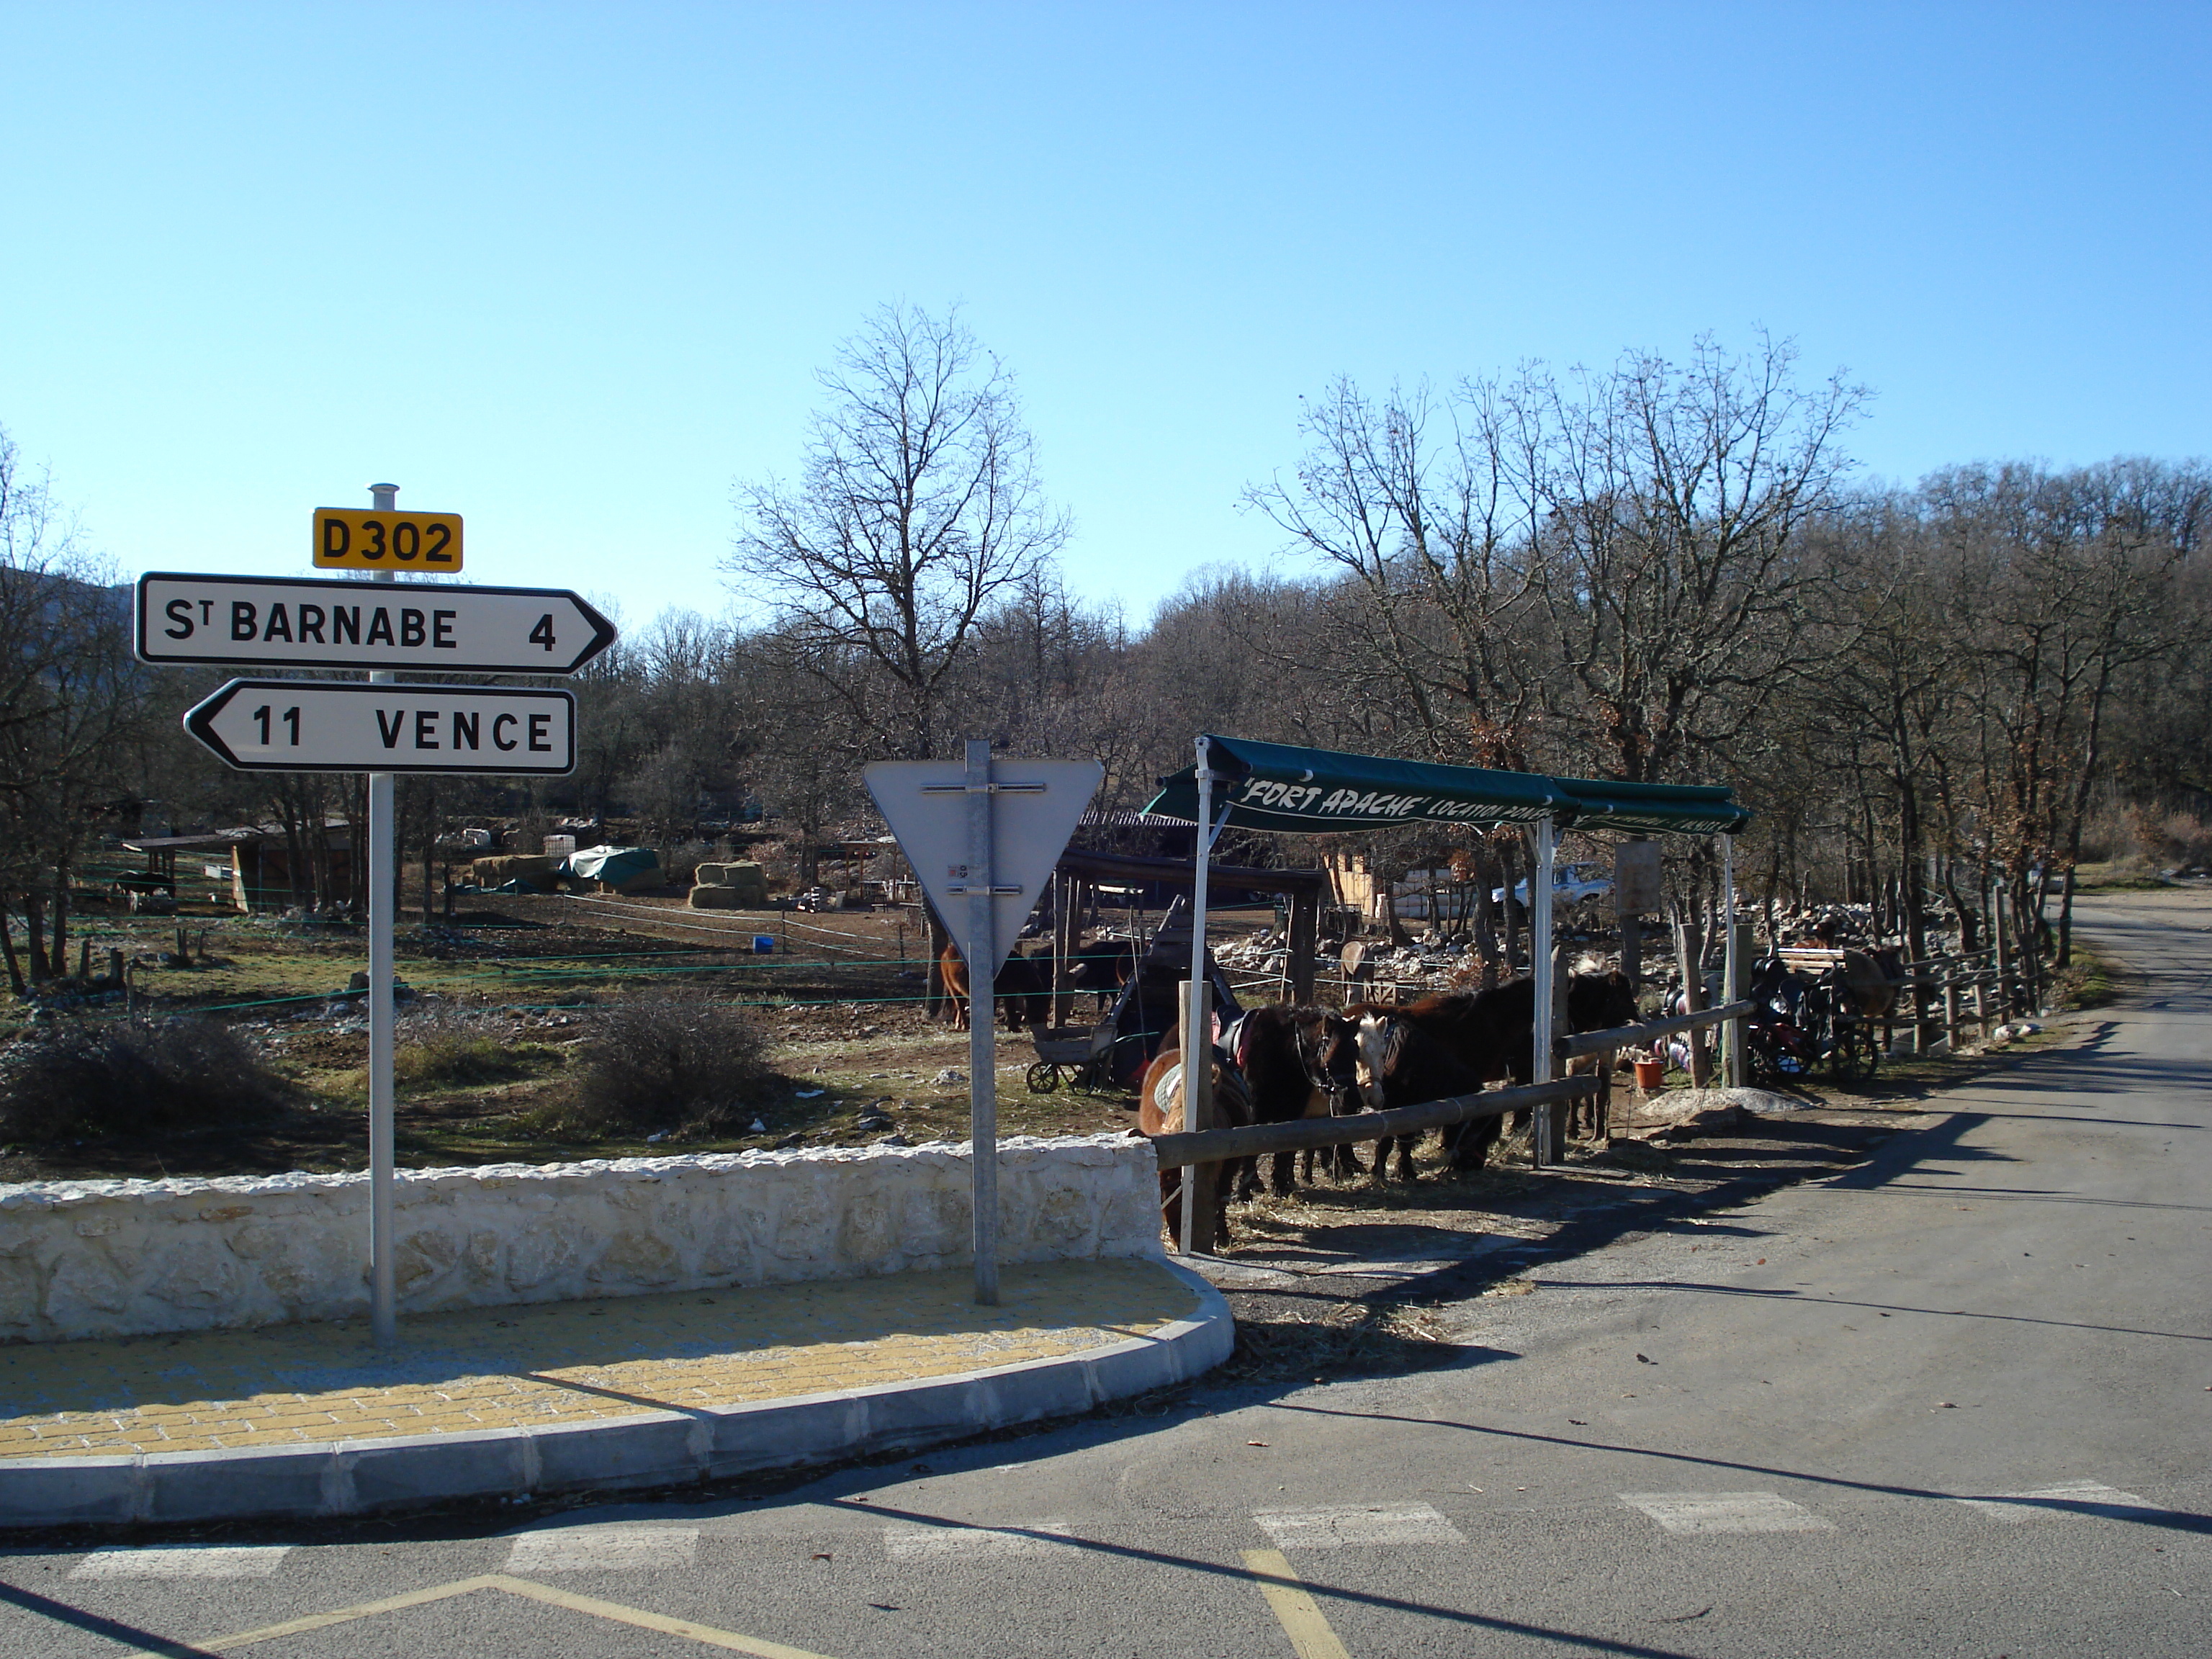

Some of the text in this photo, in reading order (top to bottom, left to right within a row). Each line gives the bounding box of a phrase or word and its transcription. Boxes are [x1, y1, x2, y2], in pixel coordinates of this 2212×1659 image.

[230, 601, 457, 649] BARNABE
[528, 613, 556, 652] 4
[253, 704, 552, 752] 11 VENCE
[1426, 799, 1506, 819] LOCATION
